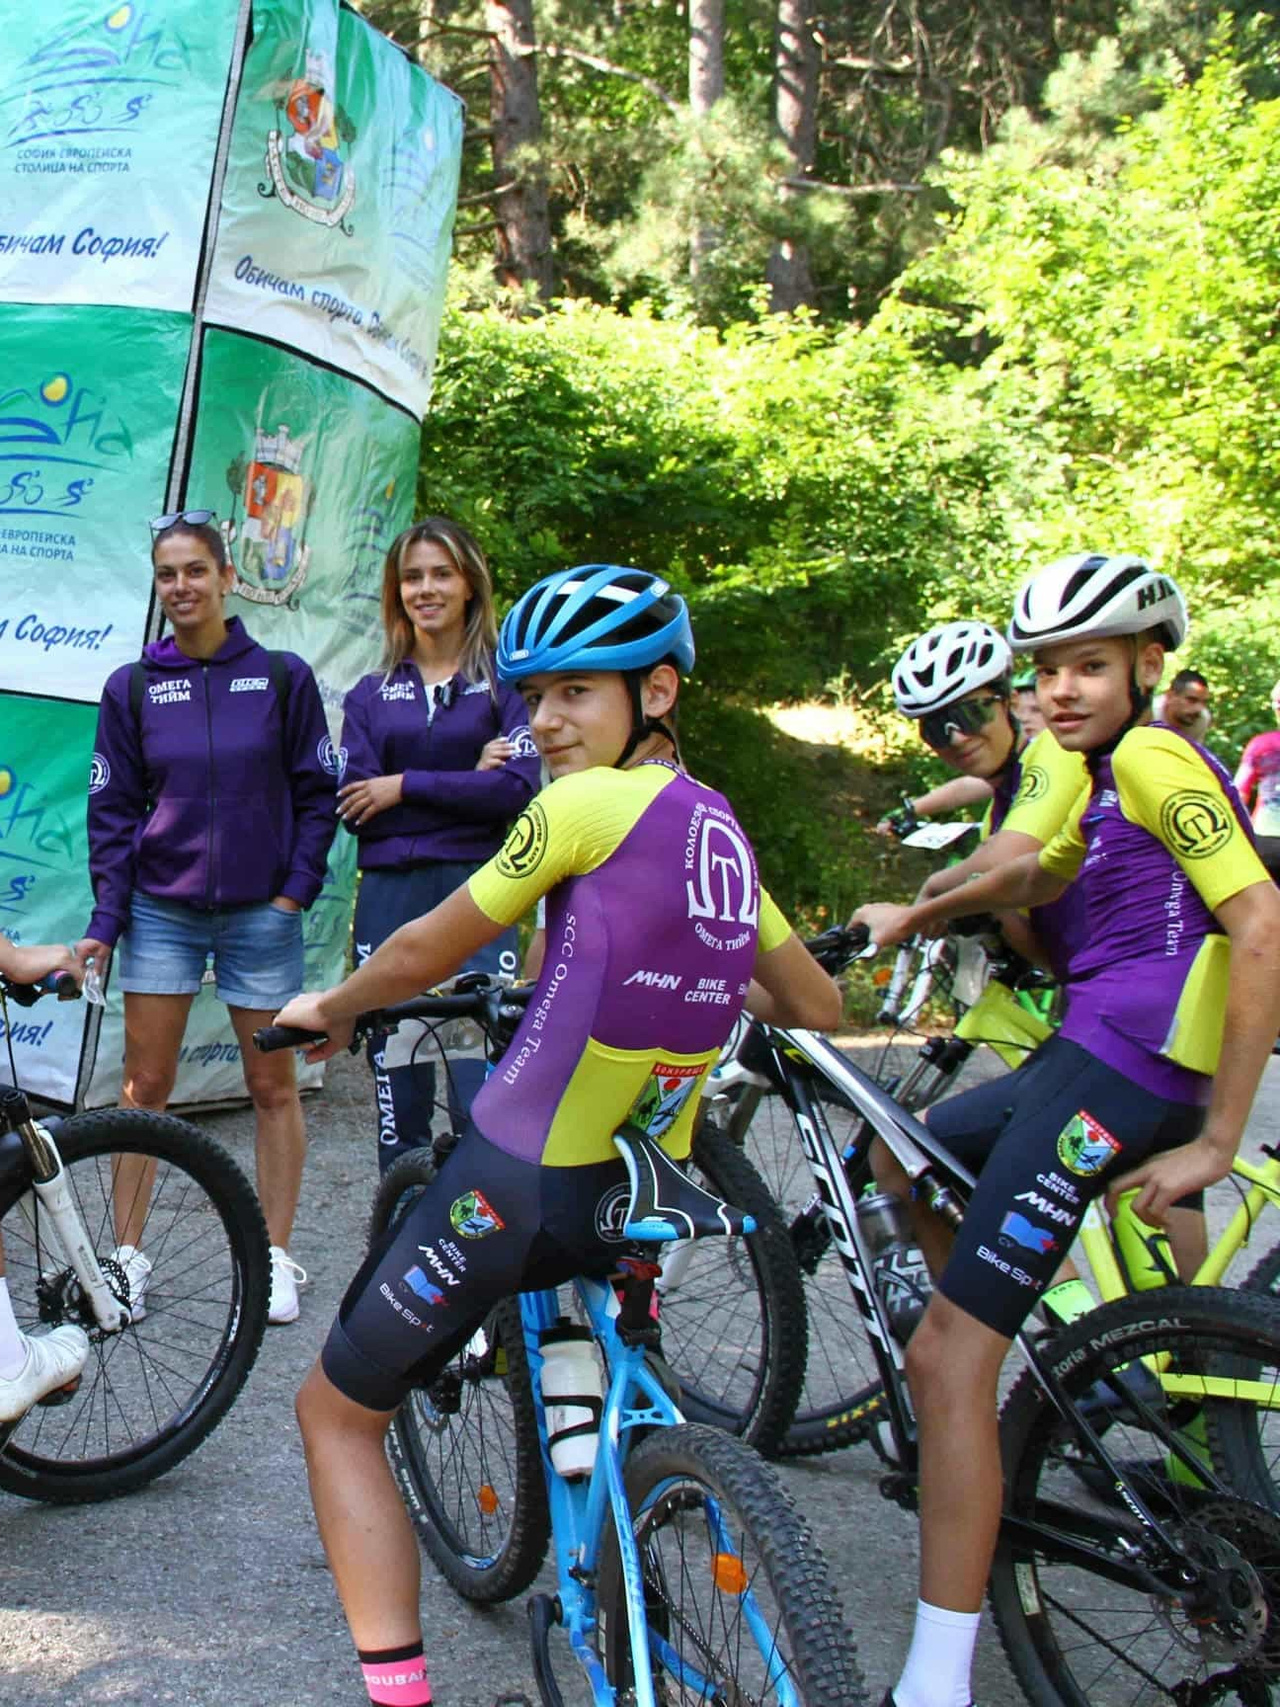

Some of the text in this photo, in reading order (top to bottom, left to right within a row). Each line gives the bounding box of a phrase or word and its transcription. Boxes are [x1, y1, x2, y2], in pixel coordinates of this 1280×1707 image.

[69, 162, 84, 173] НА
[72, 227, 170, 264] София!
[234, 254, 305, 301] Обичам
[11, 543, 27, 556] НА
[29, 547, 74, 562] СПОРТА
[14, 614, 113, 652] София!
[149, 679, 192, 696] ОМЕГА
[695, 922, 751, 951] ОМЕГА ТИЙМ
[532, 963, 568, 1031] Omega
[684, 989, 731, 1005] CENTER
[697, 978, 727, 991] BIKE
[503, 1037, 542, 1085] Team
[1036, 1173, 1080, 1205] CENTER
[1048, 1171, 1077, 1193] BIKE
[438, 1238, 467, 1273] CENTER
[448, 1241, 467, 1262] BIKE
[1089, 1317, 1191, 1351] MEZCAL
